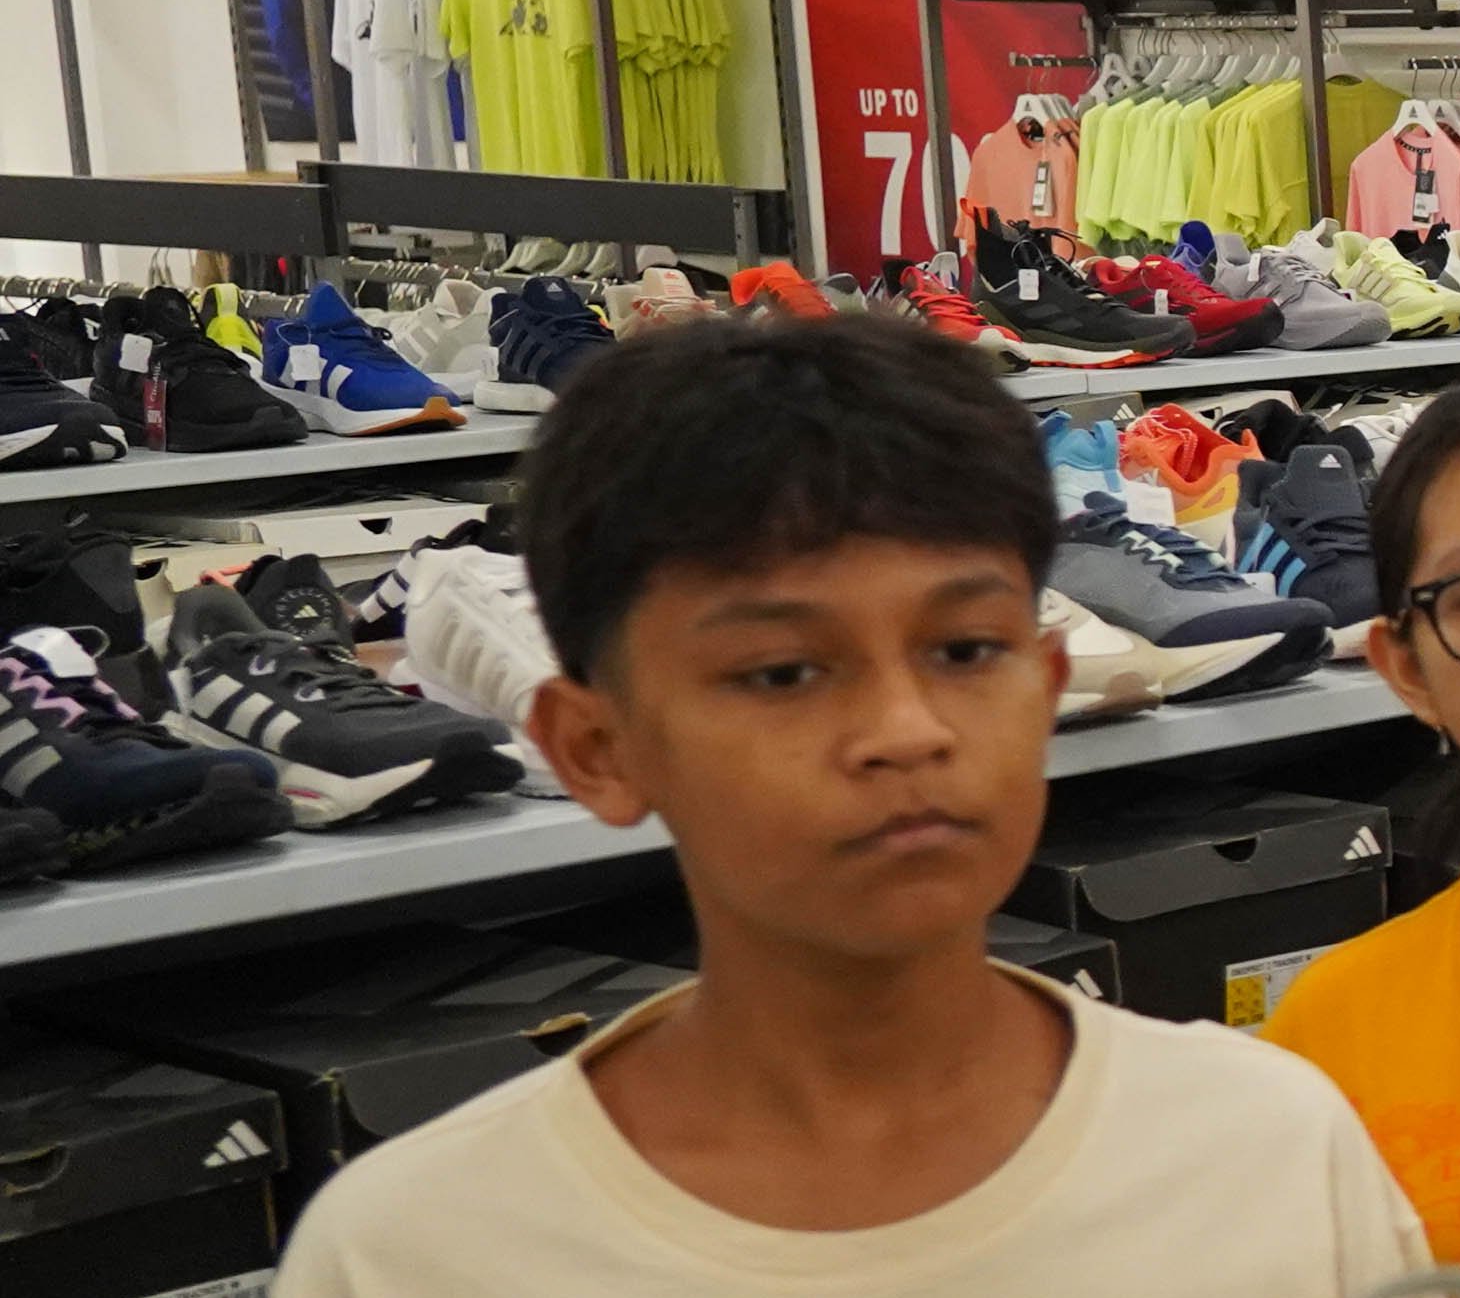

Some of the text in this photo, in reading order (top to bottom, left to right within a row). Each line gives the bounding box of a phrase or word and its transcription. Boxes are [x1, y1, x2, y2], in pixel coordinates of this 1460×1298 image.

[859, 88, 919, 117] UP TO
[864, 131, 993, 257] 70
